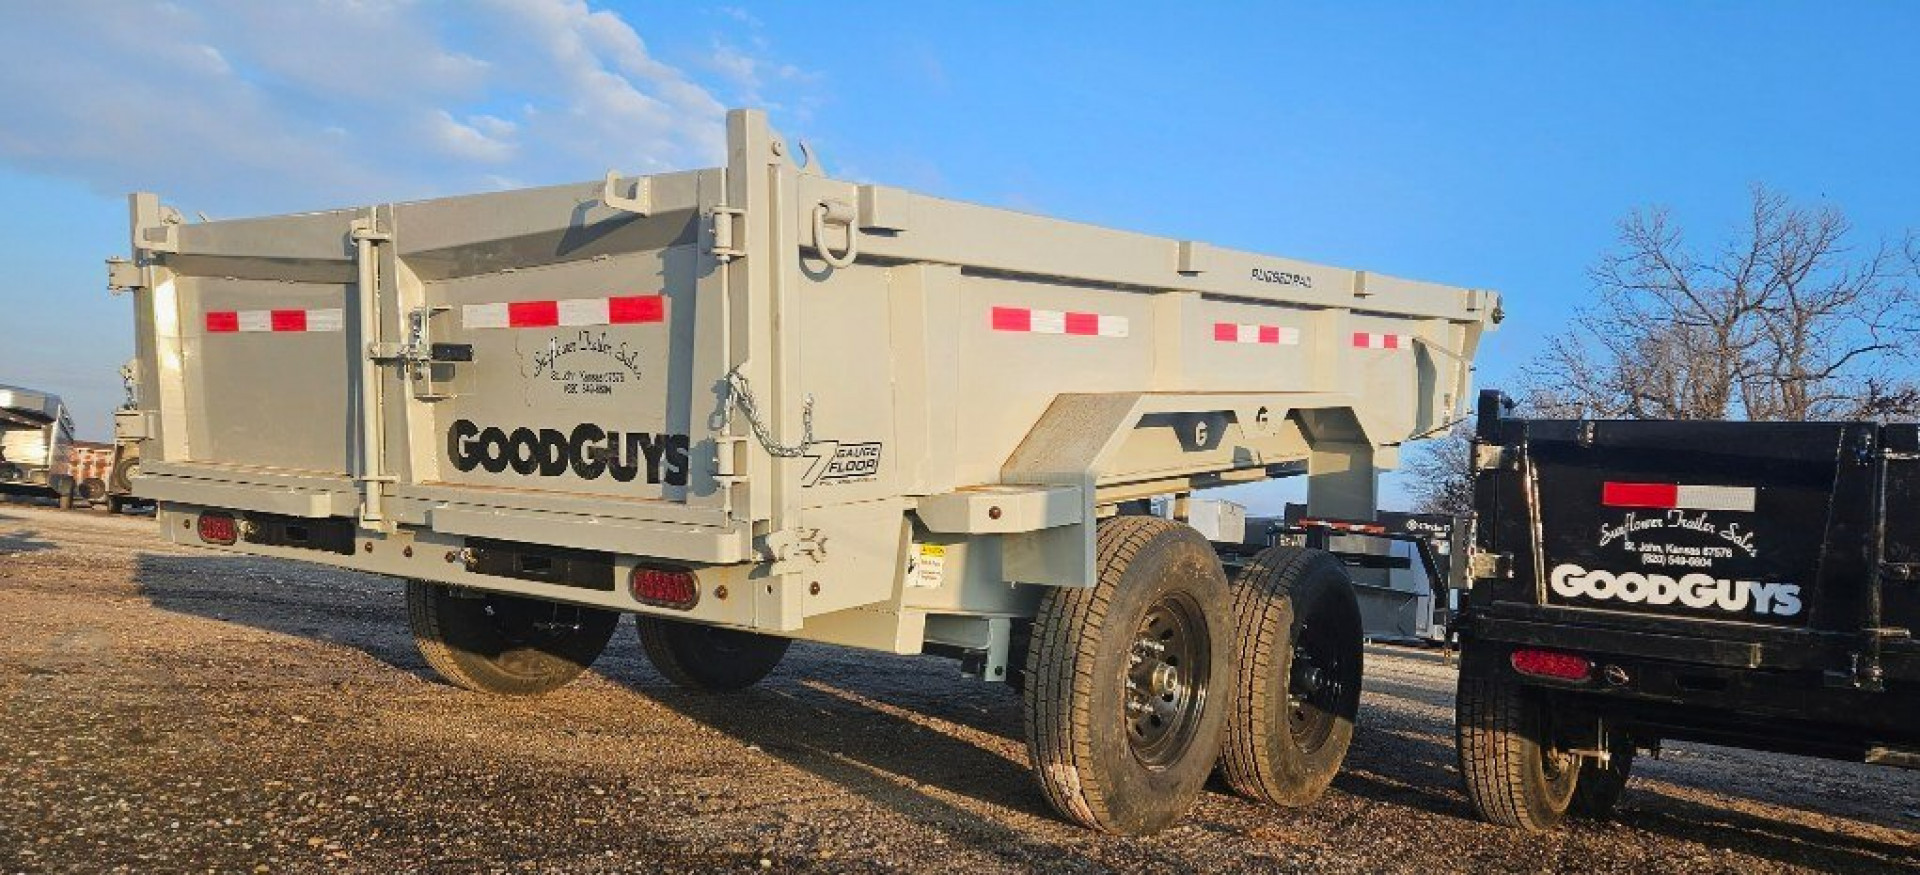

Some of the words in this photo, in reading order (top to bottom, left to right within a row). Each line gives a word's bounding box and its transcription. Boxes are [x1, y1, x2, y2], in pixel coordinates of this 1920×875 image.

[578, 330, 612, 356] Trailer
[614, 341, 641, 380] Sales
[836, 447, 879, 458] GAUGE
[828, 459, 876, 473] FLOOR
[1600, 511, 1664, 547] Sunflower
[1667, 509, 1716, 534] Trailer
[1718, 522, 1758, 558] Sales
[1665, 543, 1701, 557] Kansas
